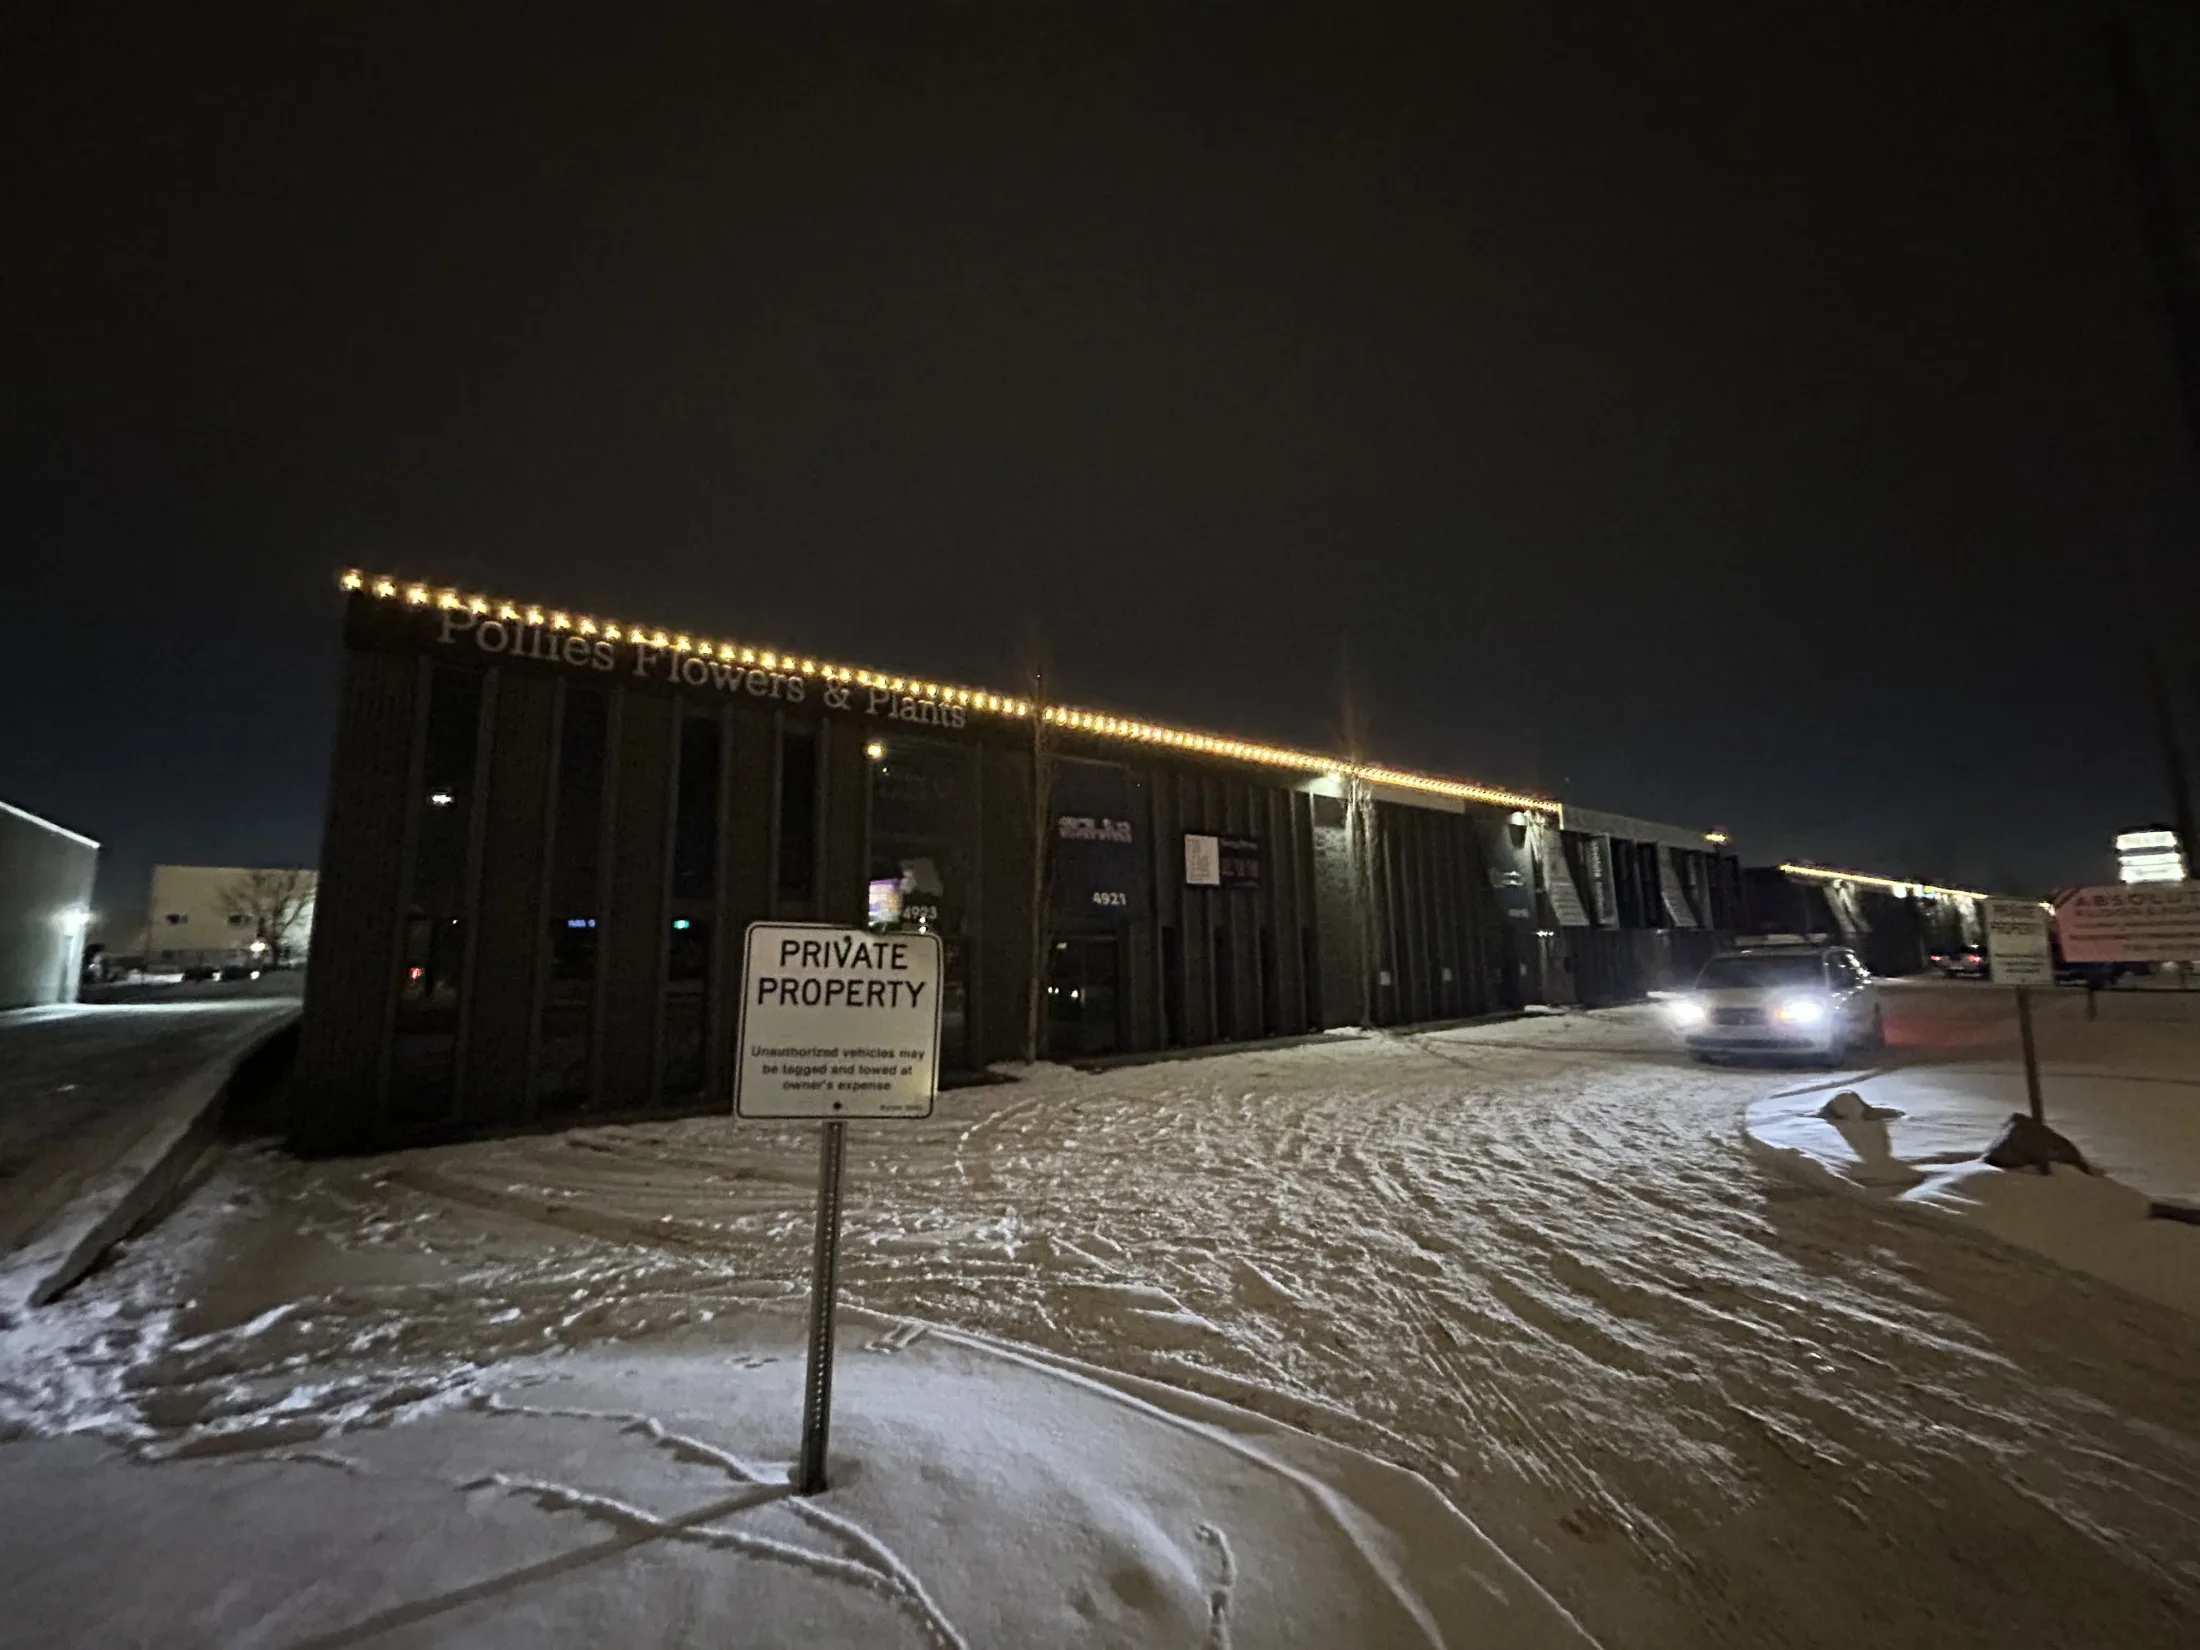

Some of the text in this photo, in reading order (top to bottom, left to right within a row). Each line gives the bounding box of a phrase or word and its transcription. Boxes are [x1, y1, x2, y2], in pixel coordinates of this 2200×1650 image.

[437, 605, 966, 729] Pollies Flowers & Plants
[1092, 892, 1127, 906] 4921
[902, 905, 938, 920] 4923
[780, 940, 908, 969] PRIVATE
[758, 977, 925, 1008] PROPERTY
[751, 1046, 925, 1061] Unauthorized vehicles may
[762, 1064, 913, 1076] be tagged and towed at
[782, 1079, 891, 1092] owner's expense
